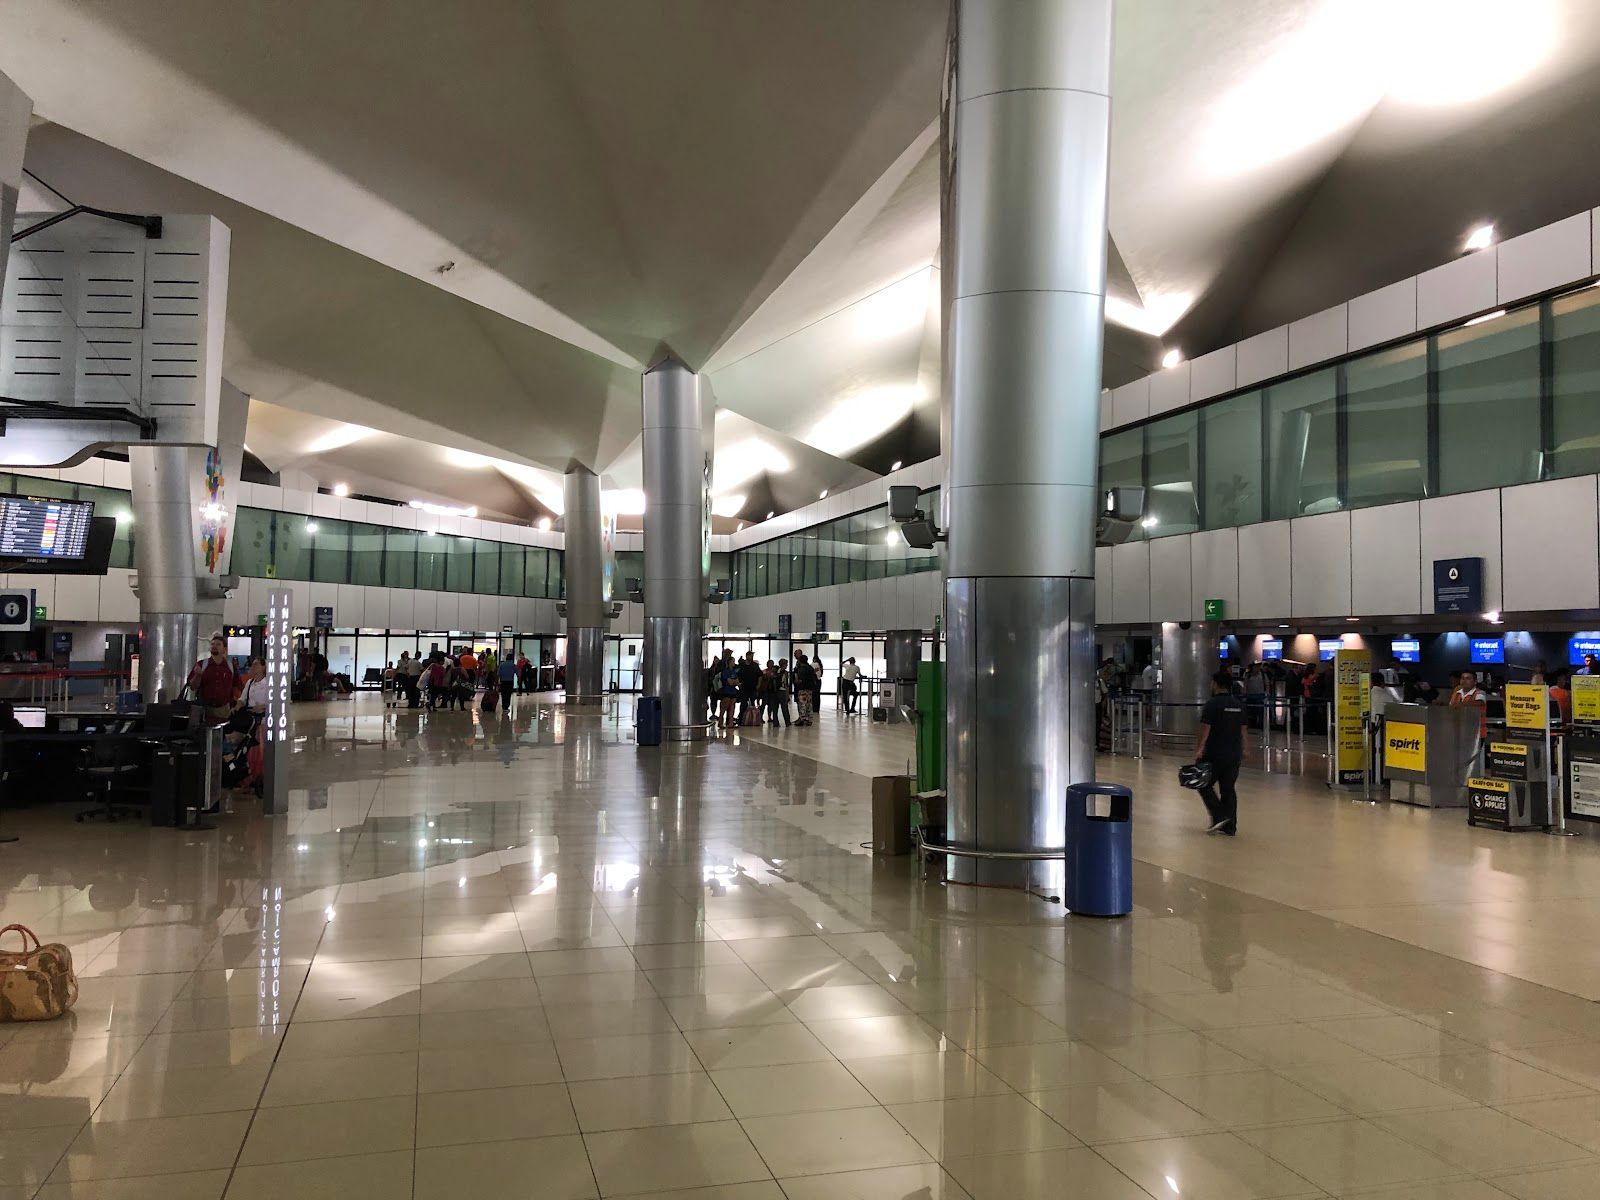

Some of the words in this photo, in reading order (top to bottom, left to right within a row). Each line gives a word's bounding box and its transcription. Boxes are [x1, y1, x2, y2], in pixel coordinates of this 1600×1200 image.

[267, 594, 275, 741] INFORMACIÓN
[279, 594, 289, 741] INFORMACIÓN
[1389, 738, 1421, 751] spirit
[1504, 759, 1525, 767] Included
[1484, 794, 1506, 802] CHARGE
[1484, 801, 1506, 810] APPLIES
